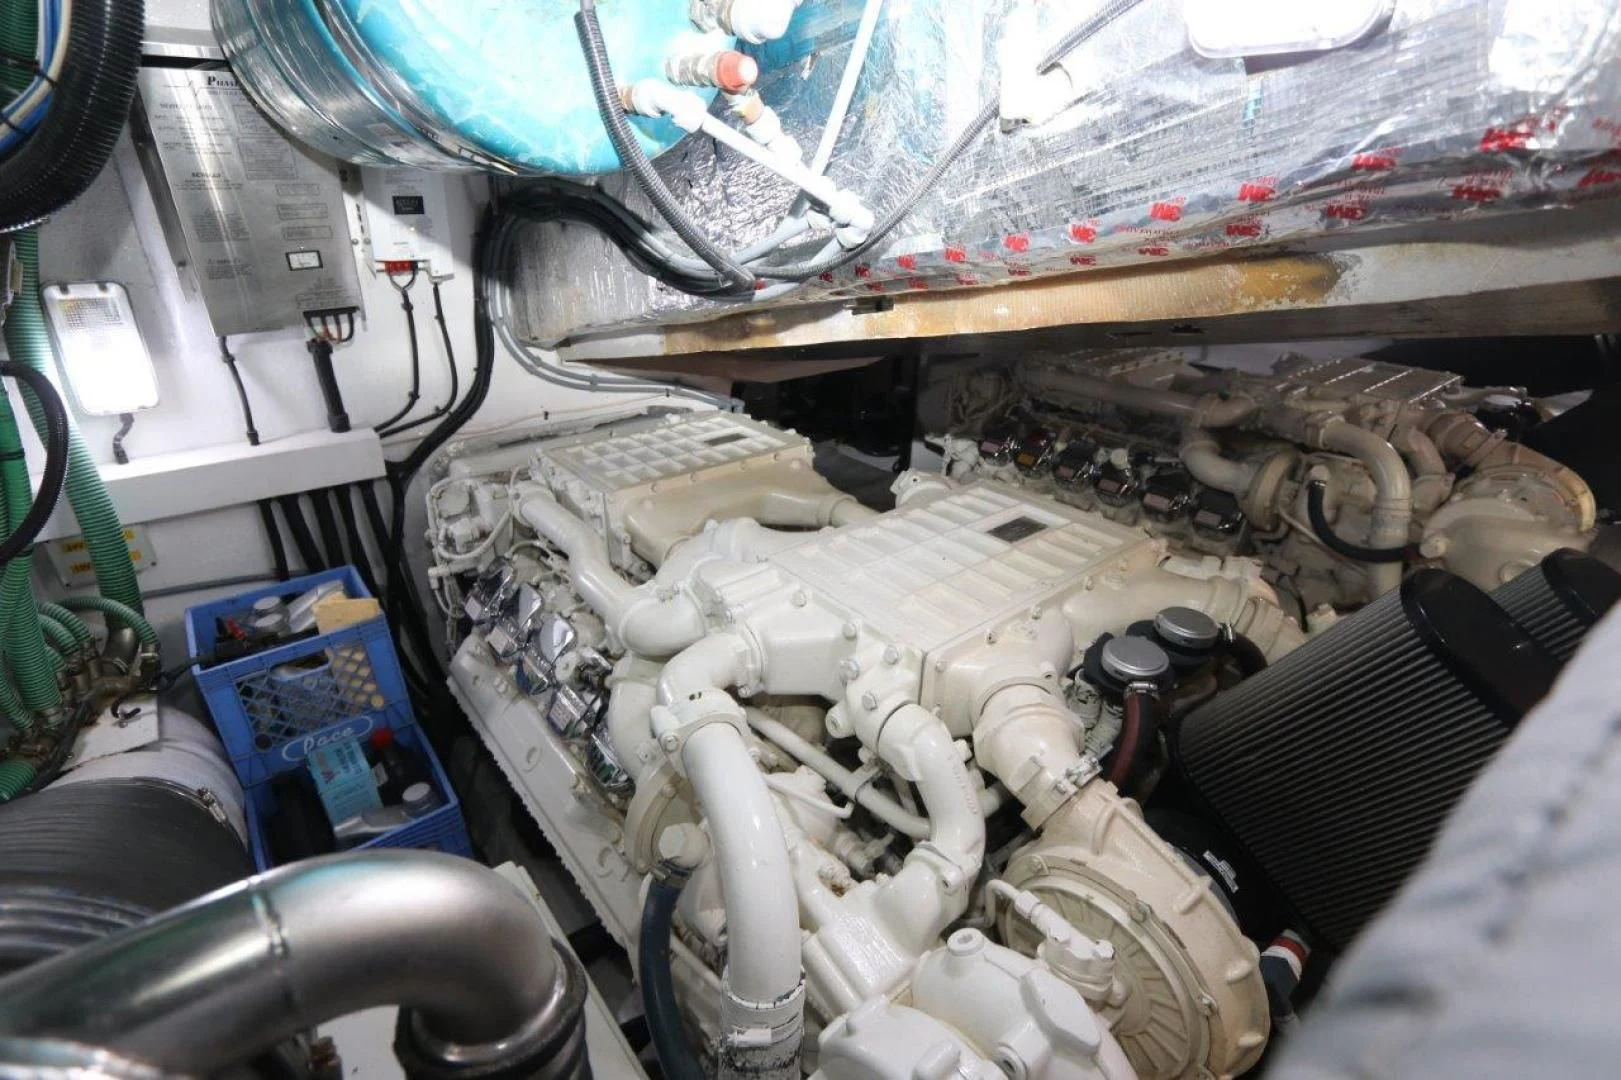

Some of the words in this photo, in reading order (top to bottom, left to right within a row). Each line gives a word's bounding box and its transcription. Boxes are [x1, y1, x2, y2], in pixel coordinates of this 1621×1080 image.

[1150, 202, 1184, 221] 3M
[1225, 224, 1263, 237] 3M
[1138, 246, 1169, 257] 3M
